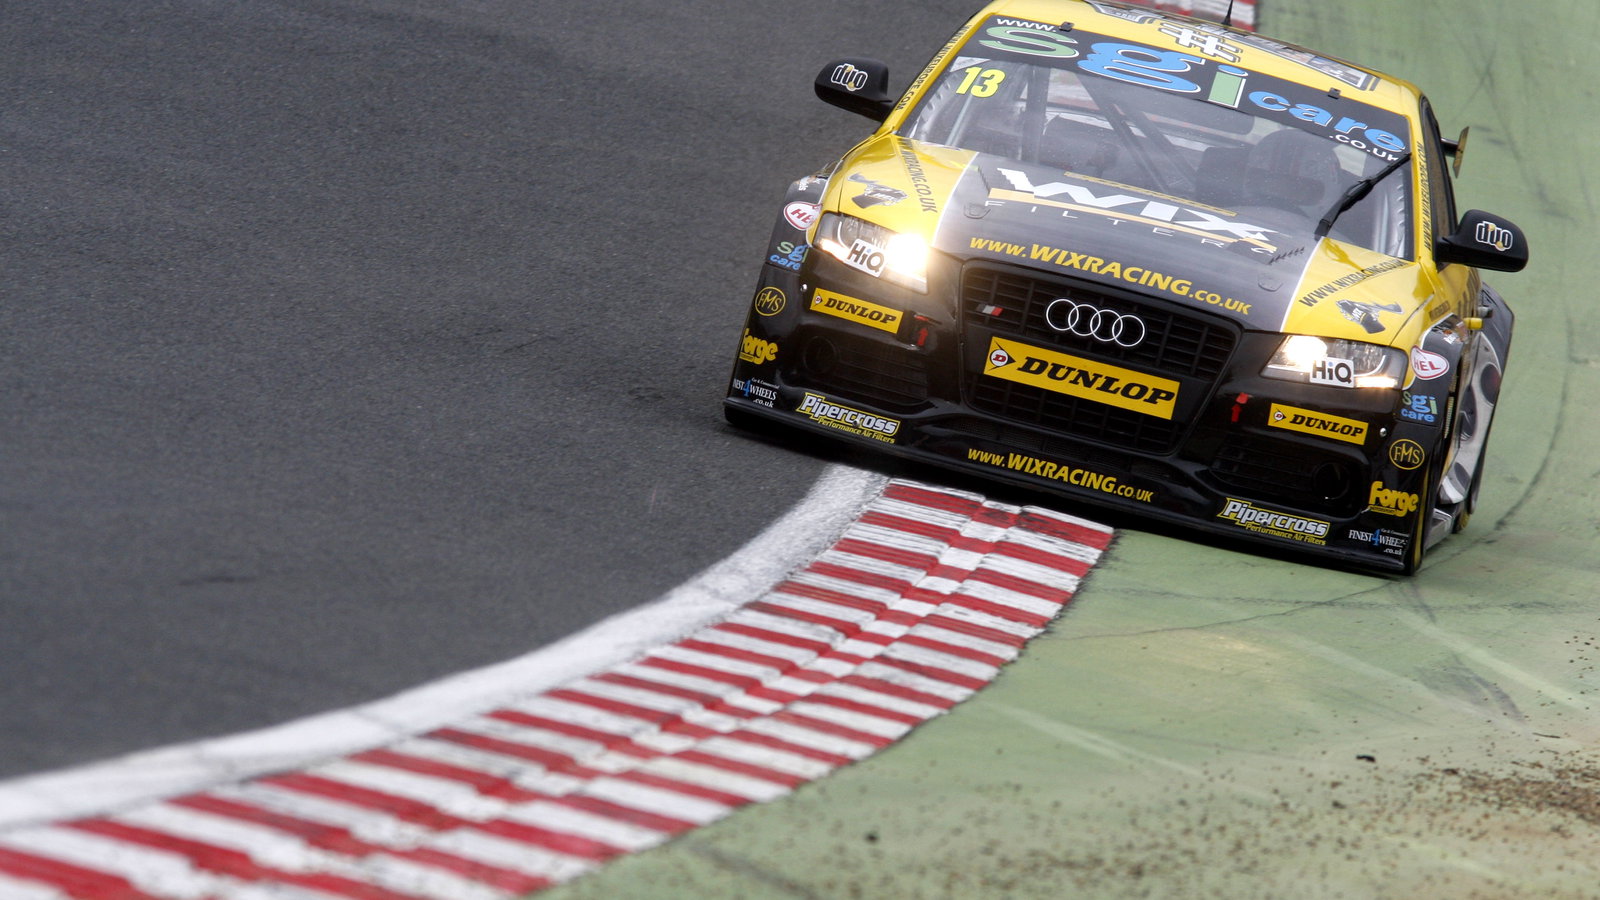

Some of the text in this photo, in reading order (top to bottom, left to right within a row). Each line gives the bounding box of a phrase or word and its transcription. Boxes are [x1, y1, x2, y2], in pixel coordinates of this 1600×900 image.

[997, 18, 1056, 32] www.
[956, 66, 1006, 98] 13
[1249, 91, 1406, 153] care
[791, 207, 814, 224] HE
[997, 168, 1289, 242] WIX
[985, 200, 1274, 257] FILTERS
[769, 254, 801, 271] care
[847, 242, 885, 274] HiQ
[757, 290, 782, 312] FMS
[824, 297, 897, 324] DUNLOP
[1017, 356, 1175, 405] DUNLOP
[1312, 361, 1352, 384] HiQ
[753, 398, 774, 408] .co.uk
[800, 395, 896, 435] Pipercross
[1401, 408, 1435, 422] care
[818, 416, 895, 444] Performance Air Filters
[1290, 414, 1364, 437] DUNLOP
[1394, 443, 1422, 464] FMS
[1223, 500, 1328, 536] Pipercross
[1292, 533, 1304, 541] Air
[1304, 535, 1326, 546] Filters
